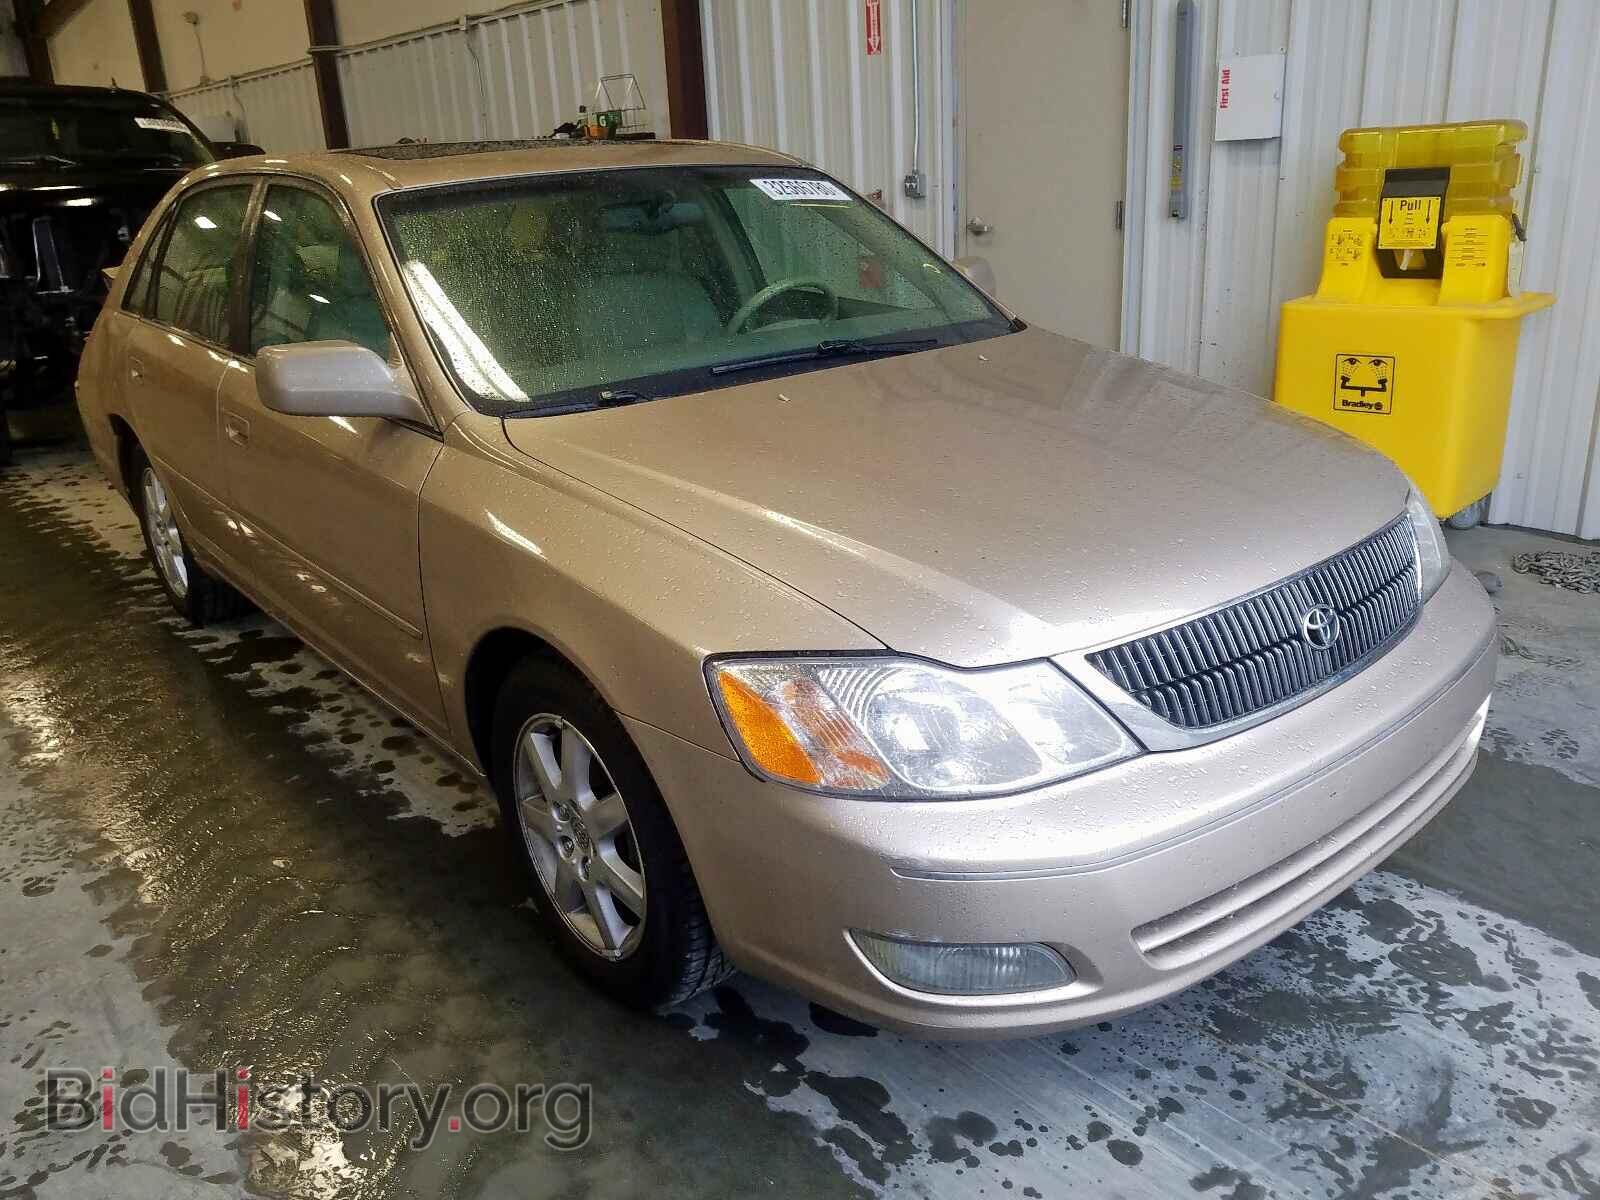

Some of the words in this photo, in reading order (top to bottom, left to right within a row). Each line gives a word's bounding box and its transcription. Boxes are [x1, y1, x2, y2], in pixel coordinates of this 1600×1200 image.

[1221, 70, 1230, 84] Aid
[1220, 88, 1229, 108] First
[1399, 199, 1422, 211] Pull
[1341, 399, 1373, 410] Bradley
